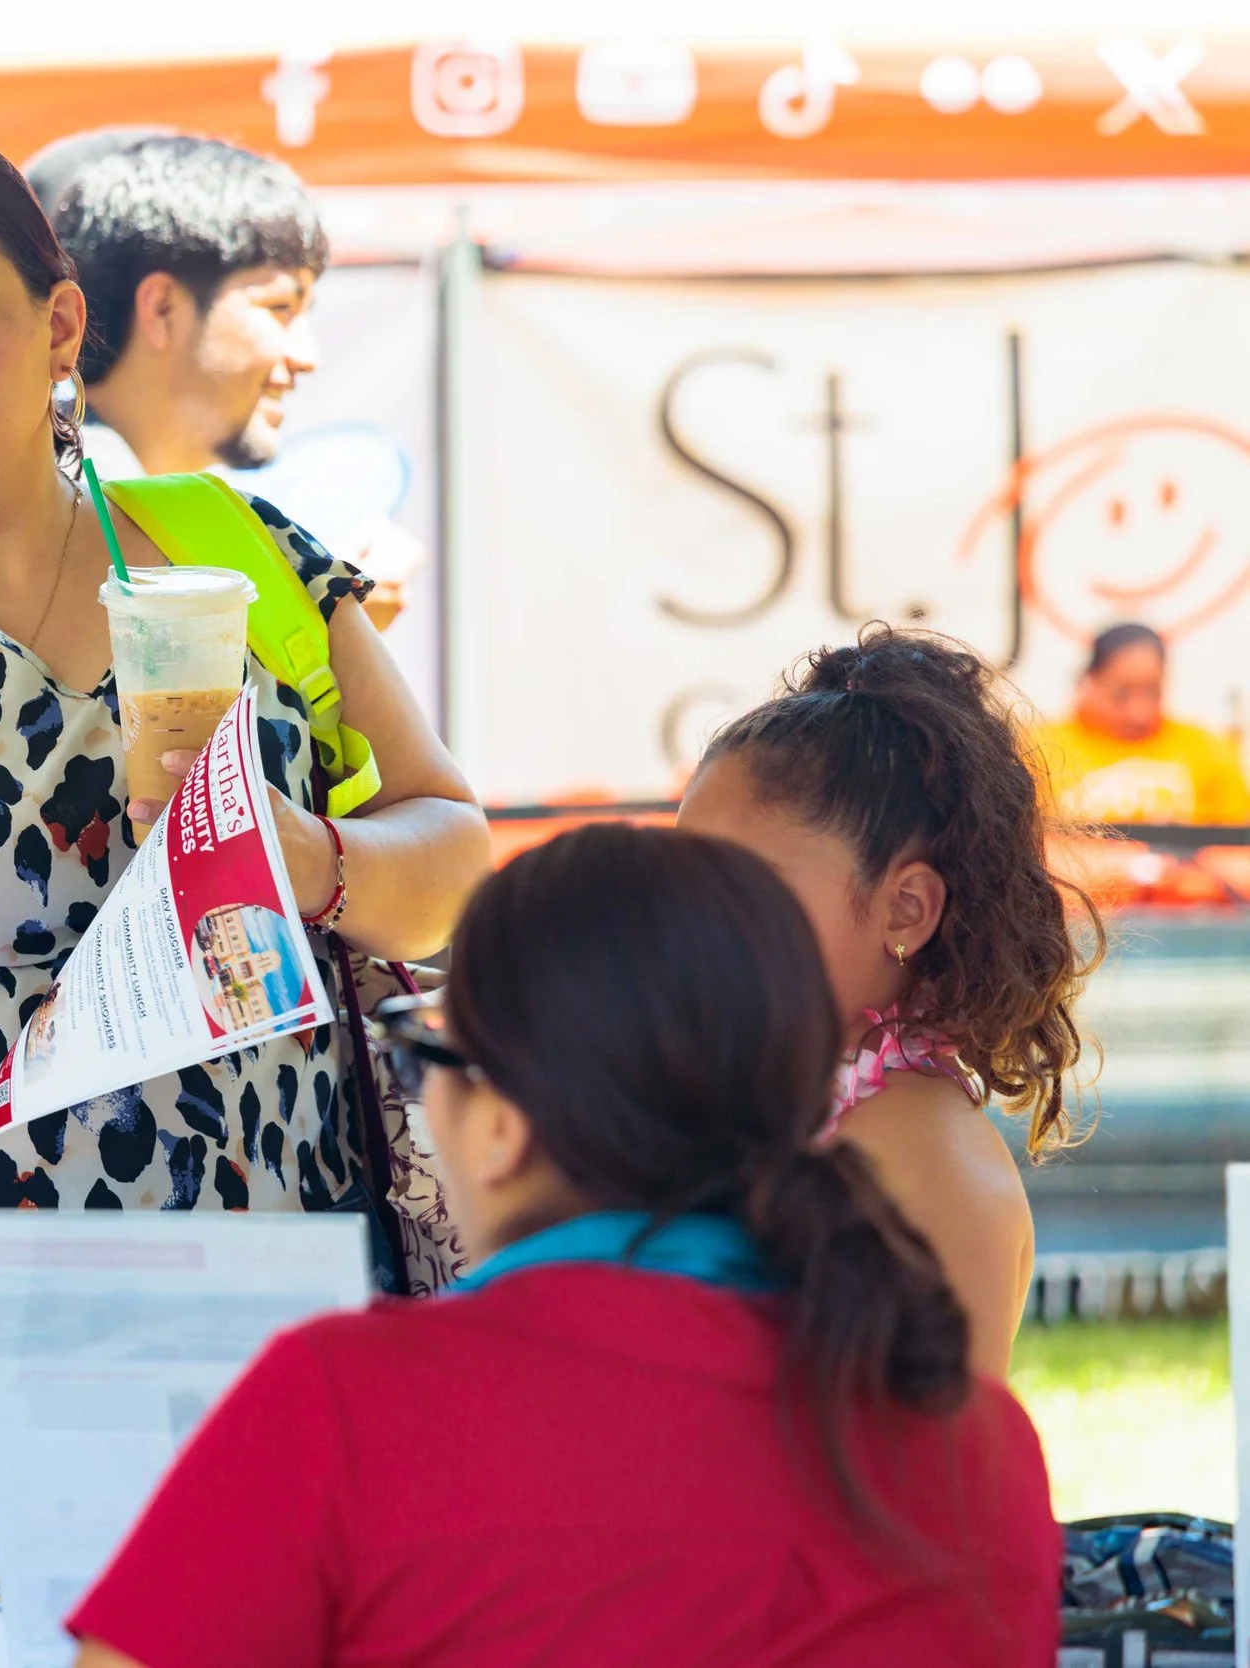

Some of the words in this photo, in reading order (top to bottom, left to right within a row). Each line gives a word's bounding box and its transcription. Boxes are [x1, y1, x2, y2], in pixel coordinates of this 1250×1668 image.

[180, 760, 197, 855] OURCES
[193, 738, 215, 852] MMUNITY
[123, 906, 138, 976] COMMUNITY
[133, 980, 148, 1018] LUNCH
[160, 887, 171, 913] DMV
[166, 914, 184, 969] VOUCHER
[95, 924, 105, 990] COMMUNITY
[100, 994, 117, 1049] SHOWERS
